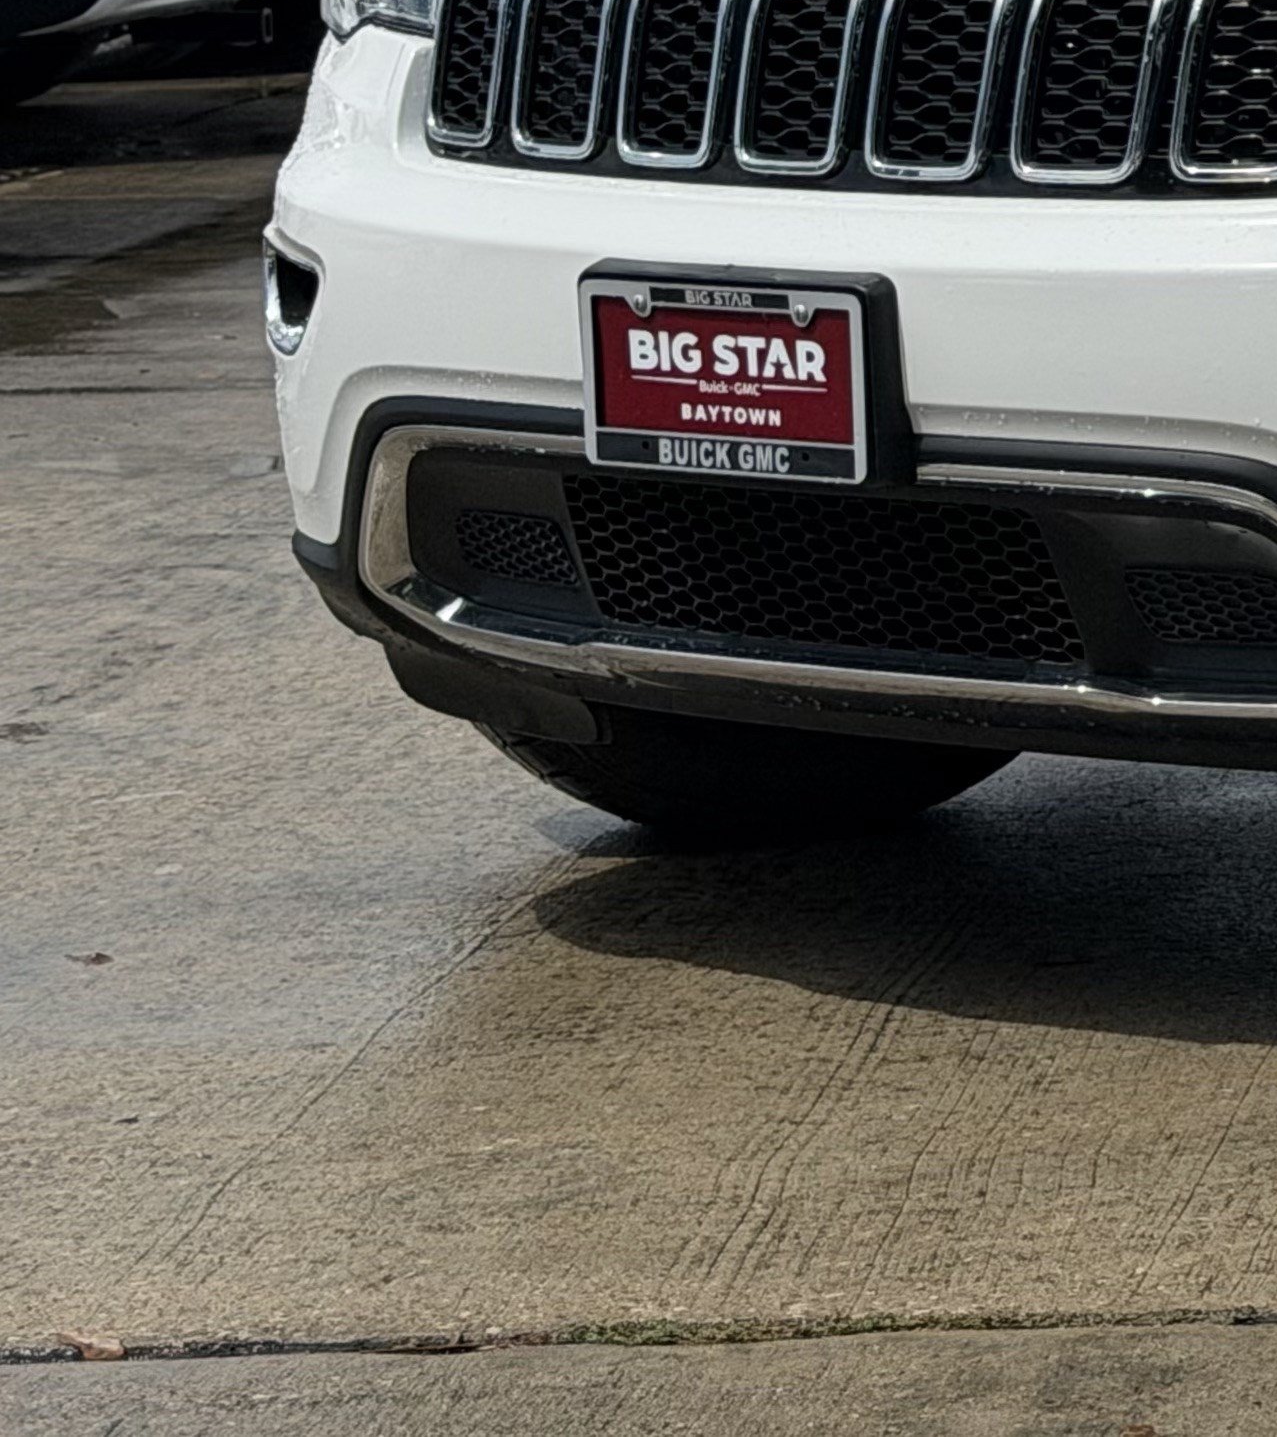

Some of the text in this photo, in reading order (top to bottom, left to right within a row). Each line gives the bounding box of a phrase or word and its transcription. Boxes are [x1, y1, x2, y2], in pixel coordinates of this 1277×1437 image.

[684, 289, 753, 308] BIG STAR
[627, 328, 828, 383] BIG STAR
[699, 379, 762, 397] Buick GMC
[680, 402, 782, 427] BAYTOWN
[658, 437, 791, 474] BUICK GMC
